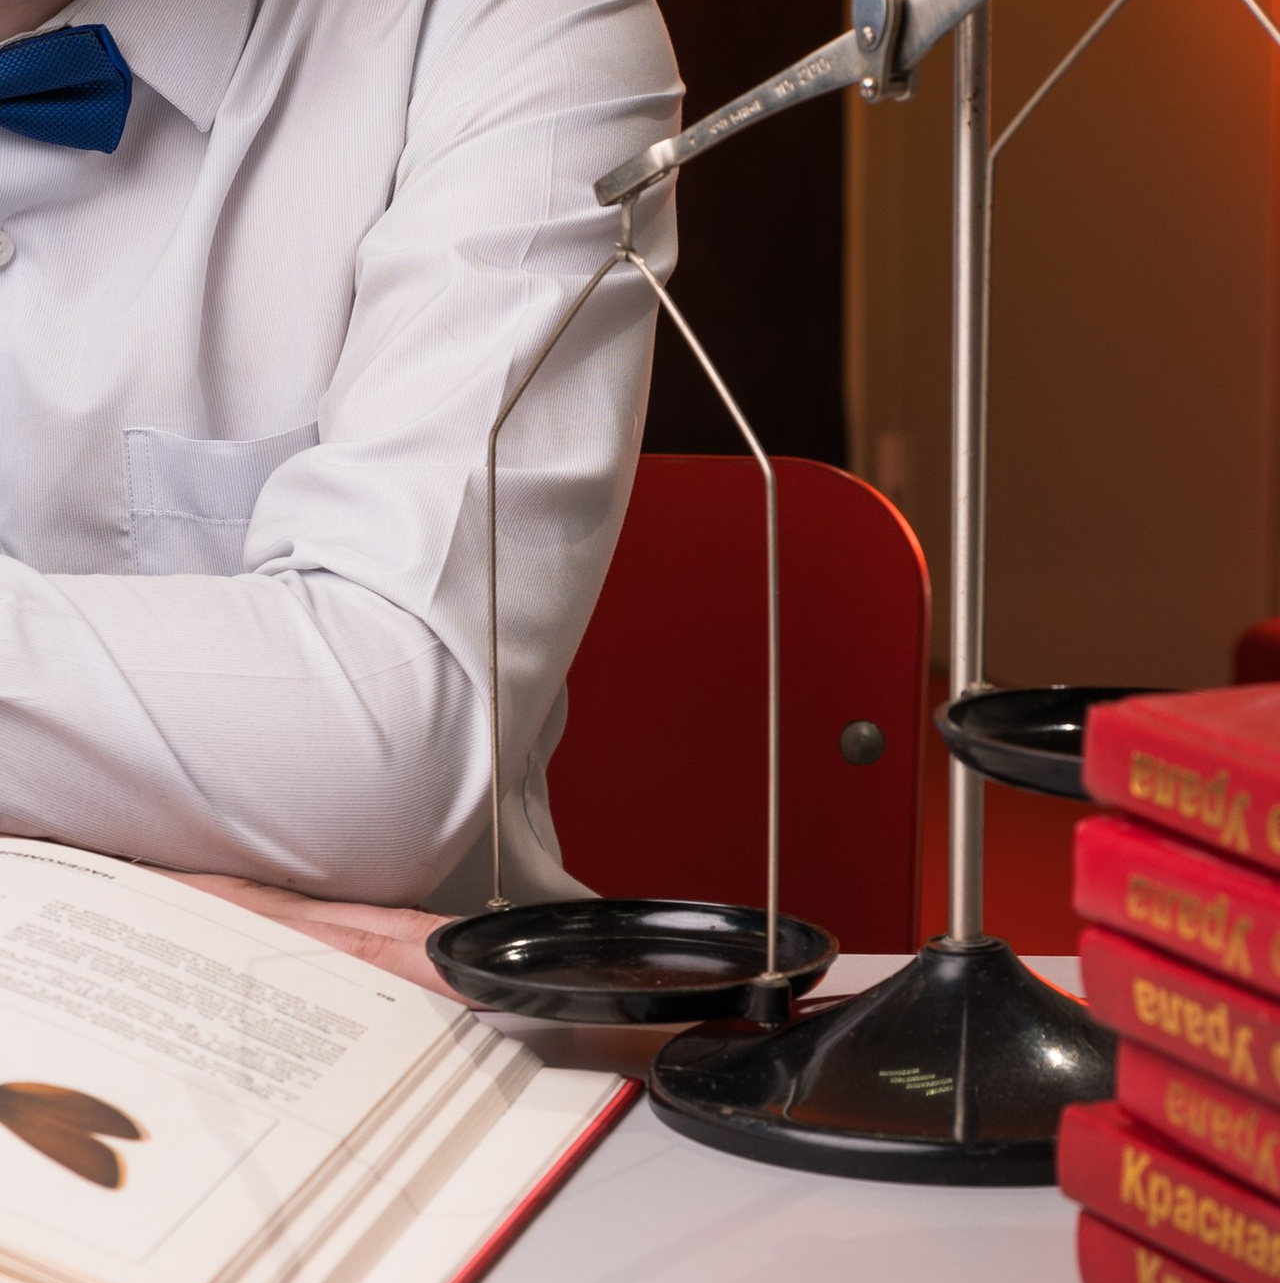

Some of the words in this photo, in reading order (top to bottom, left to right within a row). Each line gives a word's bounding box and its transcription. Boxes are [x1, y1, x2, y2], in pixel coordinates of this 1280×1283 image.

[1128, 749, 1252, 854] Урала
[1125, 874, 1253, 978] Урала
[1132, 977, 1259, 1086] Урала
[1164, 1080, 1280, 1193] Урала
